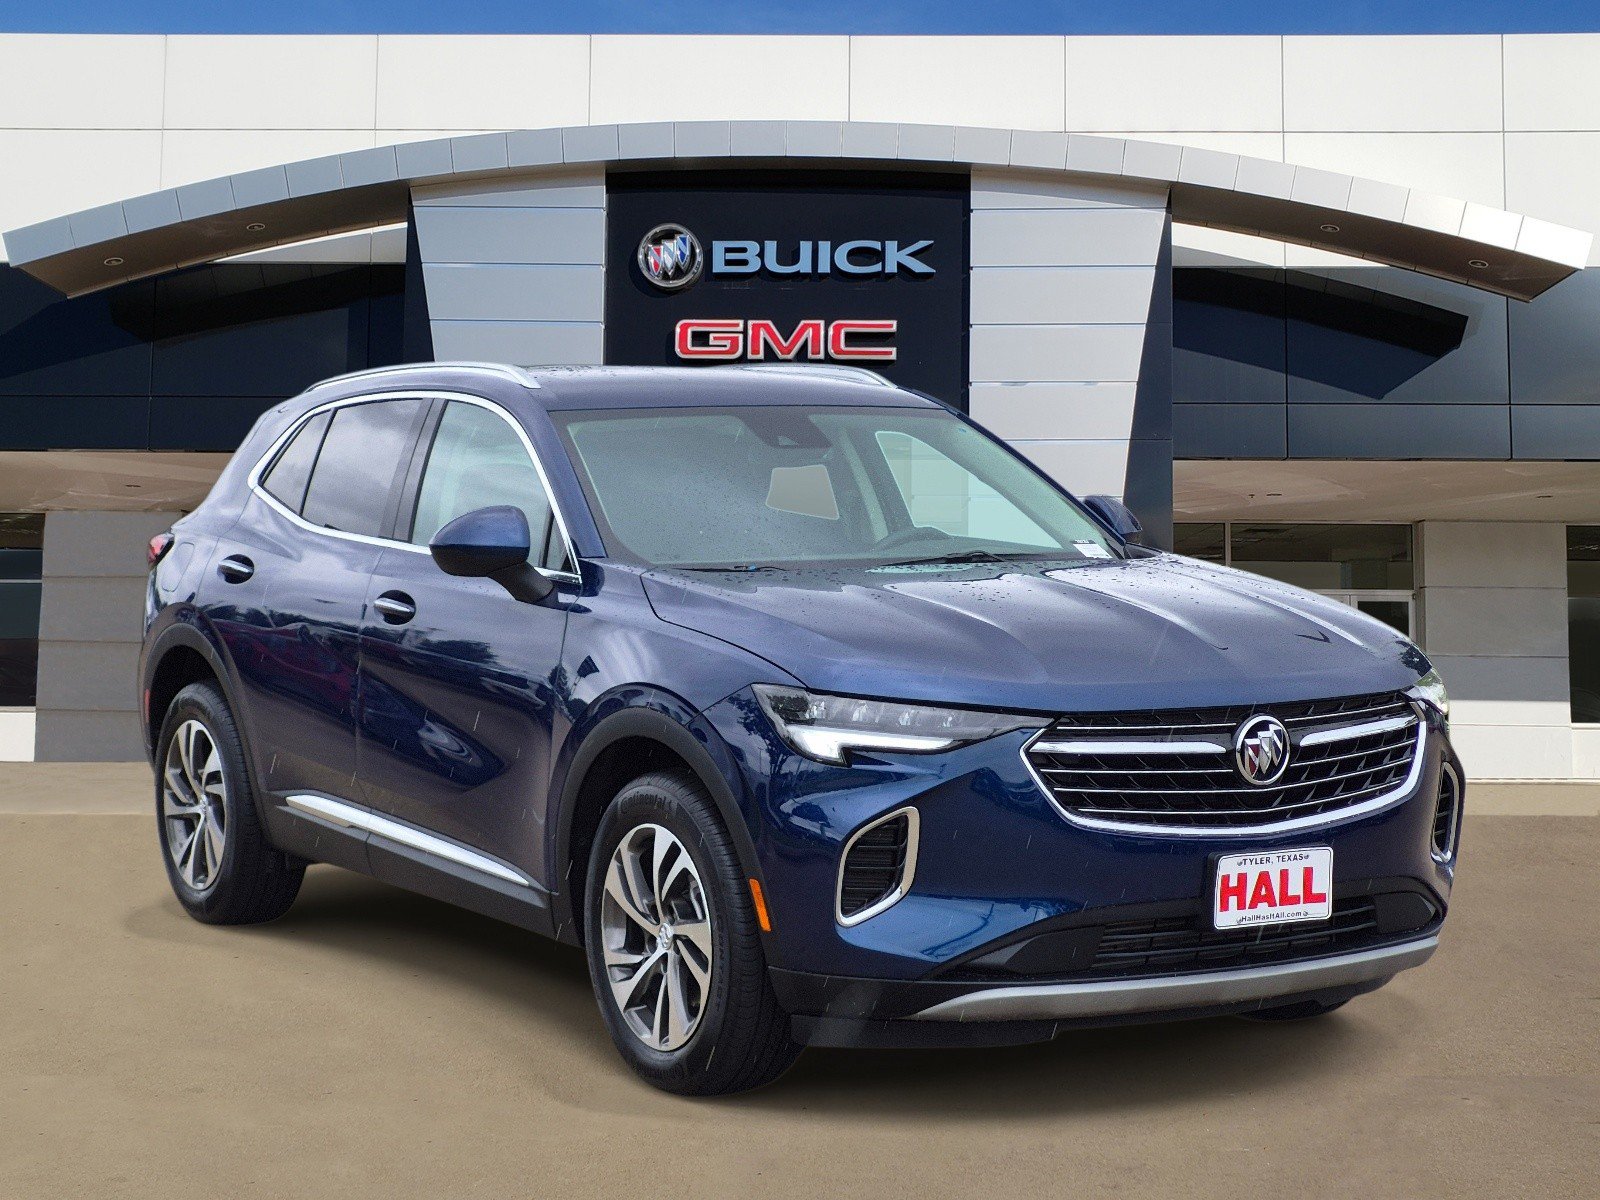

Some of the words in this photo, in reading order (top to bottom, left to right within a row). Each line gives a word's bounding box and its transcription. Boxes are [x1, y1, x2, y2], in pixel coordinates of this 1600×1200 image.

[712, 240, 936, 274] BUICK
[675, 319, 898, 360] GMC
[1242, 856, 1273, 865] TYLER,
[1276, 853, 1304, 863] TEXAS
[1220, 867, 1326, 912] HALL
